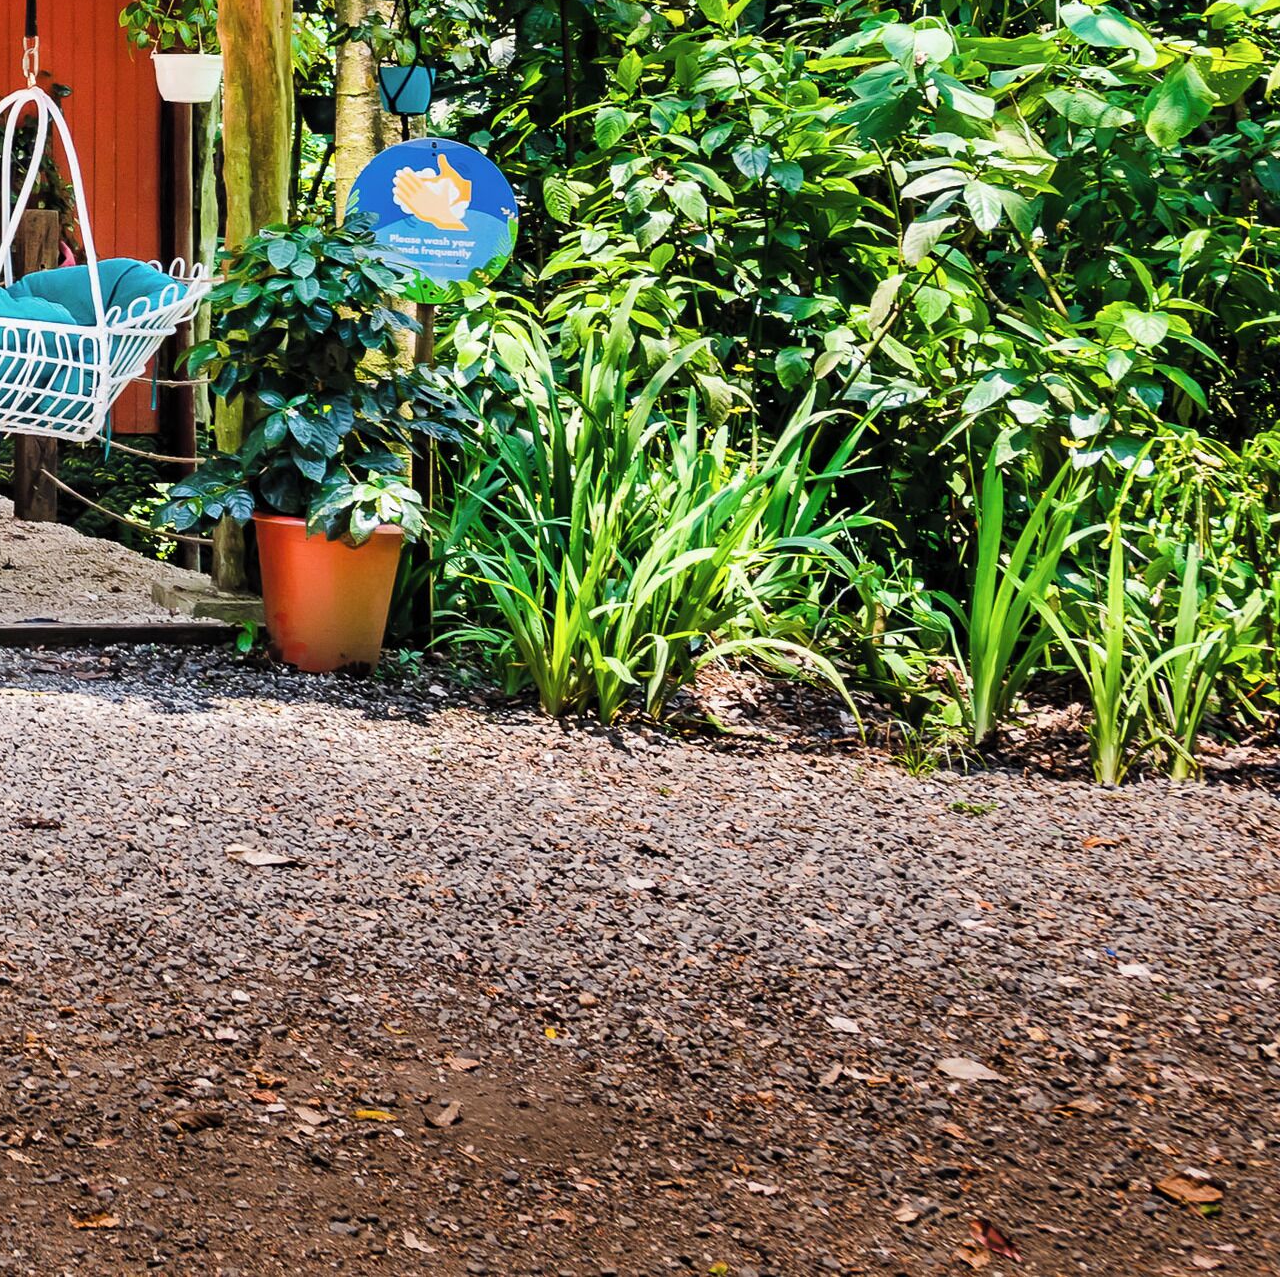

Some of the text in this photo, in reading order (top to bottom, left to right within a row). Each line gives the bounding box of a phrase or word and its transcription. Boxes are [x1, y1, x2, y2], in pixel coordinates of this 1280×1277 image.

[389, 233, 476, 249] Please wash your
[421, 245, 472, 259] frequently
